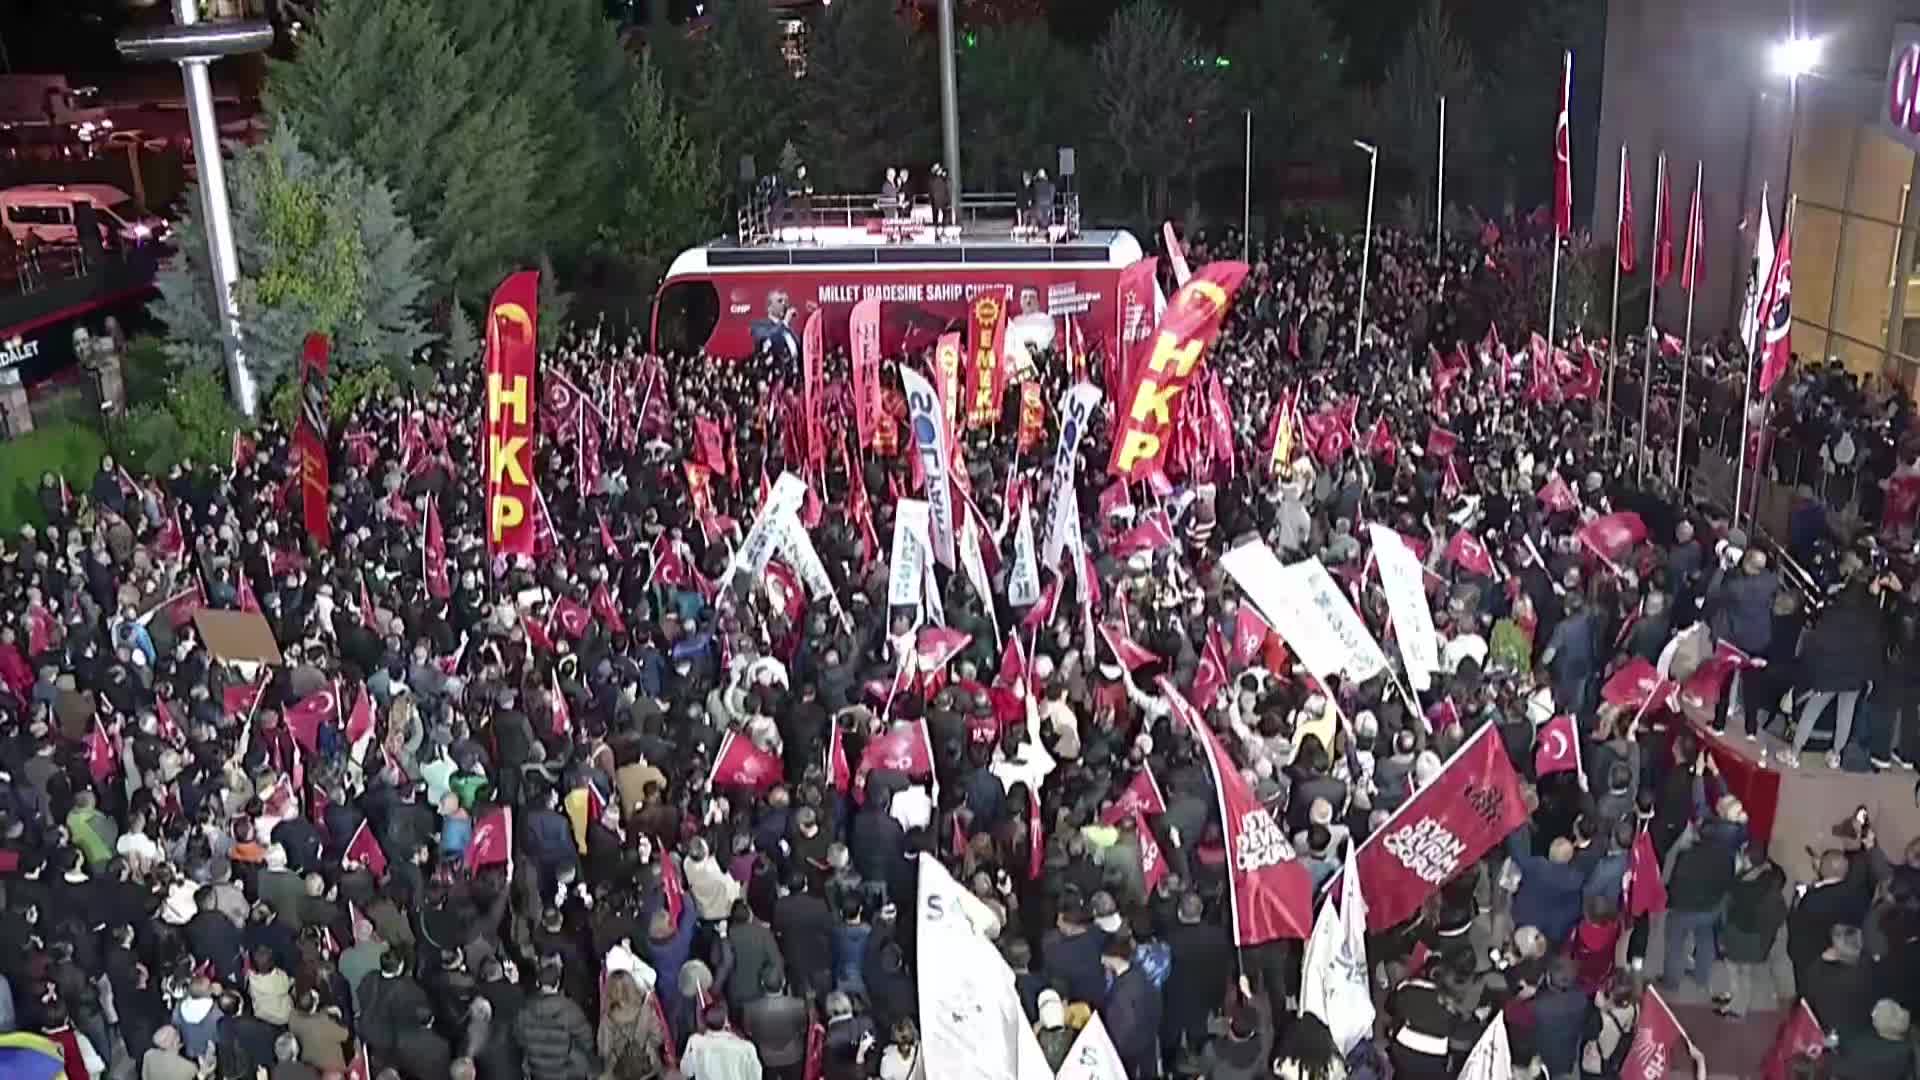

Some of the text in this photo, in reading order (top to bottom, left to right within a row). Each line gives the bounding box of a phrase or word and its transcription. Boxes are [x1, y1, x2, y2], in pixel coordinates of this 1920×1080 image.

[0, 340, 39, 368] DALET
[1117, 331, 1204, 472] HKP
[488, 373, 529, 543] HKP
